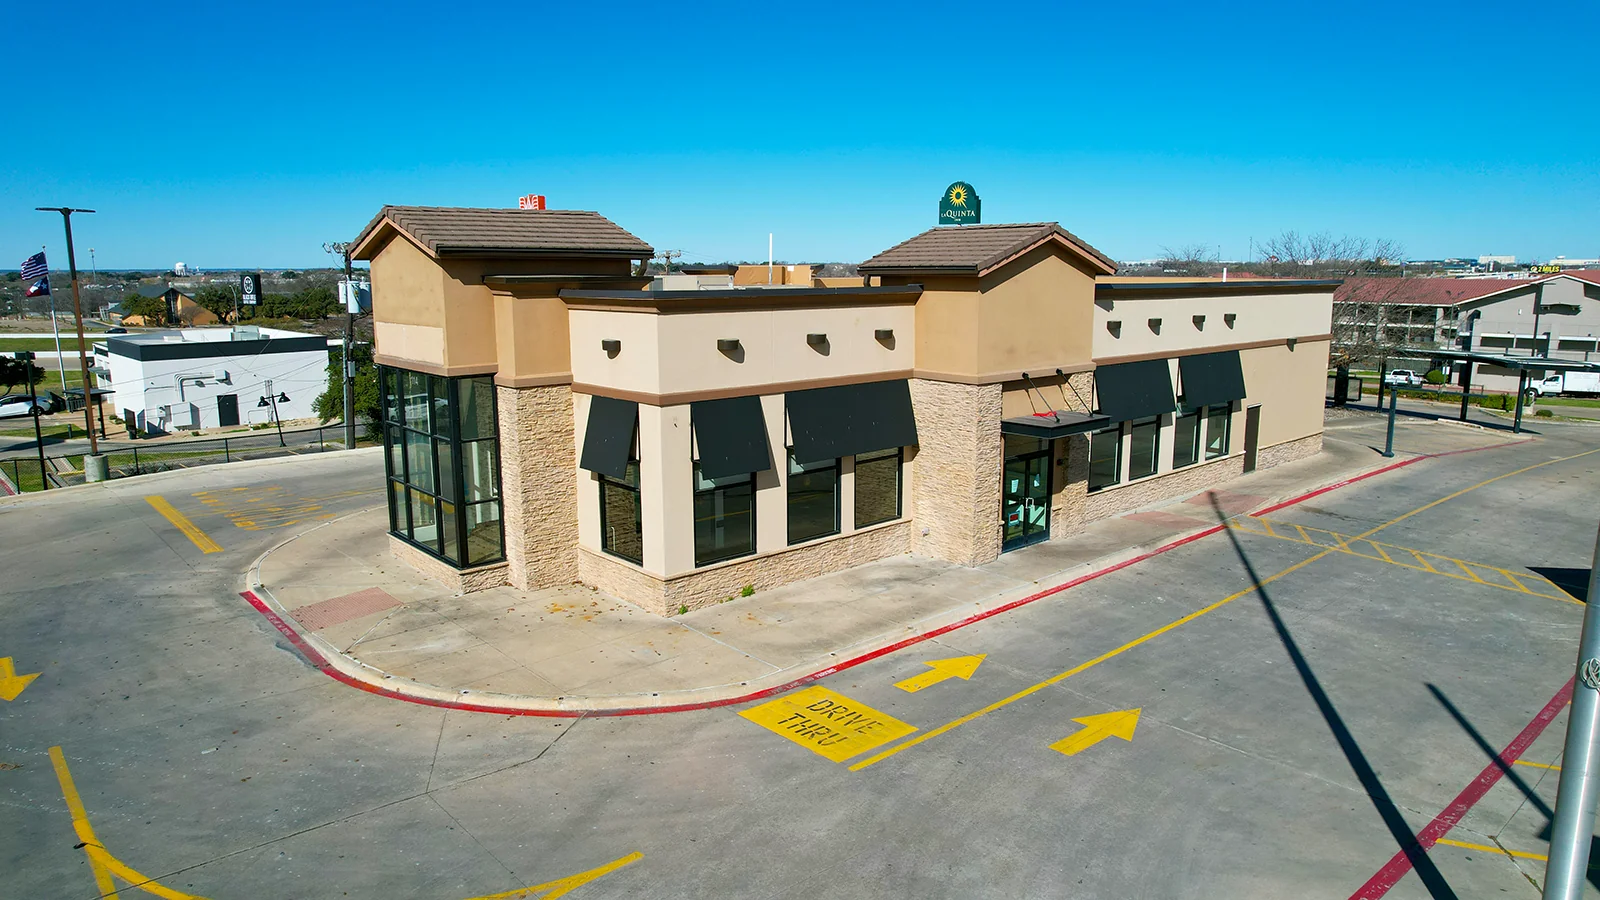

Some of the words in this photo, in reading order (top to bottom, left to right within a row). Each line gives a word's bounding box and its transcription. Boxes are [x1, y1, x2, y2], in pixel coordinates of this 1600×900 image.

[946, 210, 975, 219] QUINTA
[777, 712, 848, 747] THRU
[806, 699, 884, 735] DRIVE
